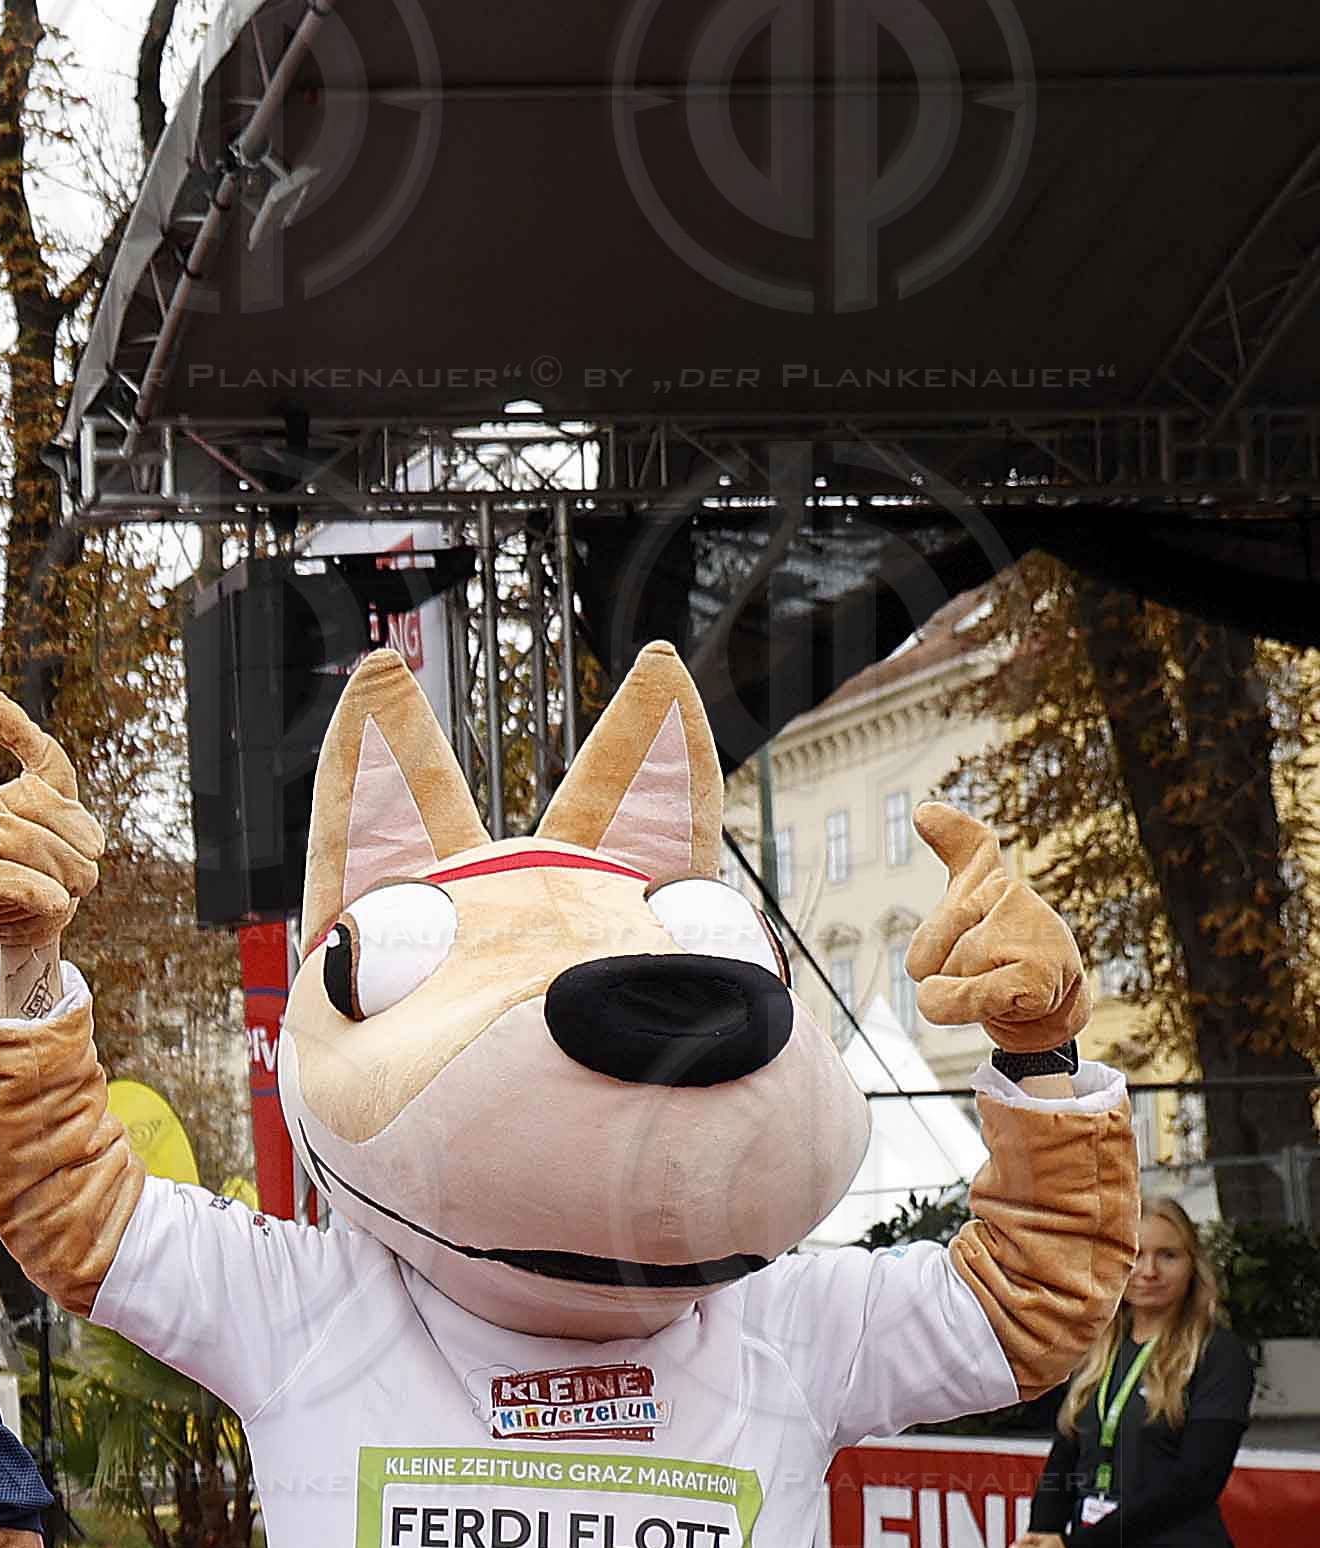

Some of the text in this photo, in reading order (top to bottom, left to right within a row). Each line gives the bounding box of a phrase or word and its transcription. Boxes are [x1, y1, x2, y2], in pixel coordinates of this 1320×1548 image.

[501, 1373, 642, 1404] KLEINE
[384, 1456, 738, 1497] KLEINE ZEITUNG GRAZ MARATHON
